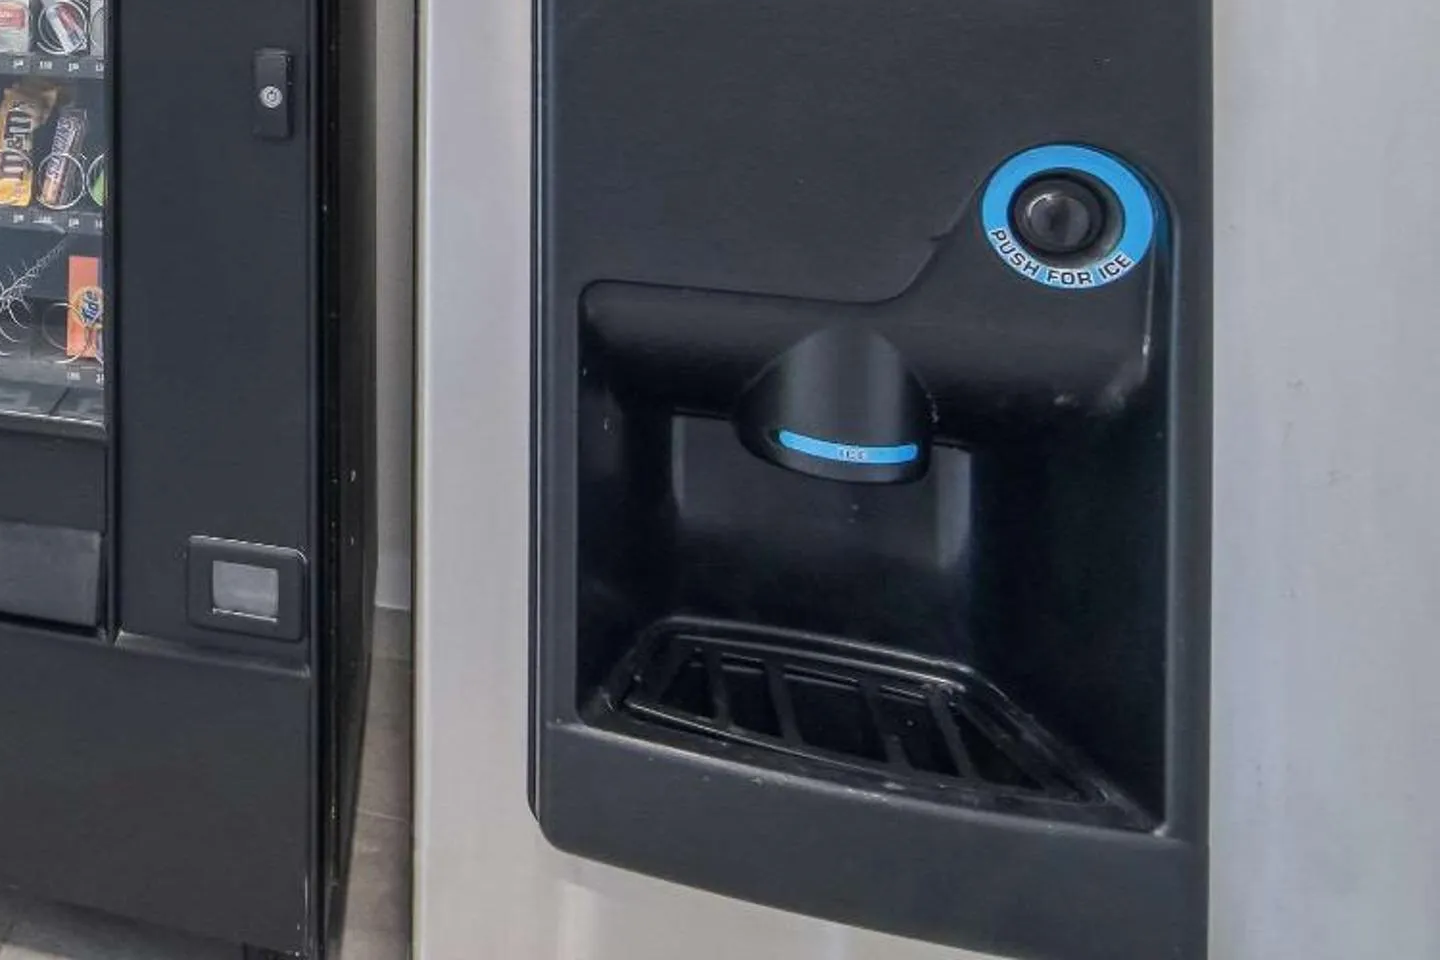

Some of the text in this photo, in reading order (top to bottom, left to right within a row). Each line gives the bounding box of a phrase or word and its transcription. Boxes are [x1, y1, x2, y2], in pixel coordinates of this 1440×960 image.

[991, 227, 1132, 285] PUSH FOR ICE
